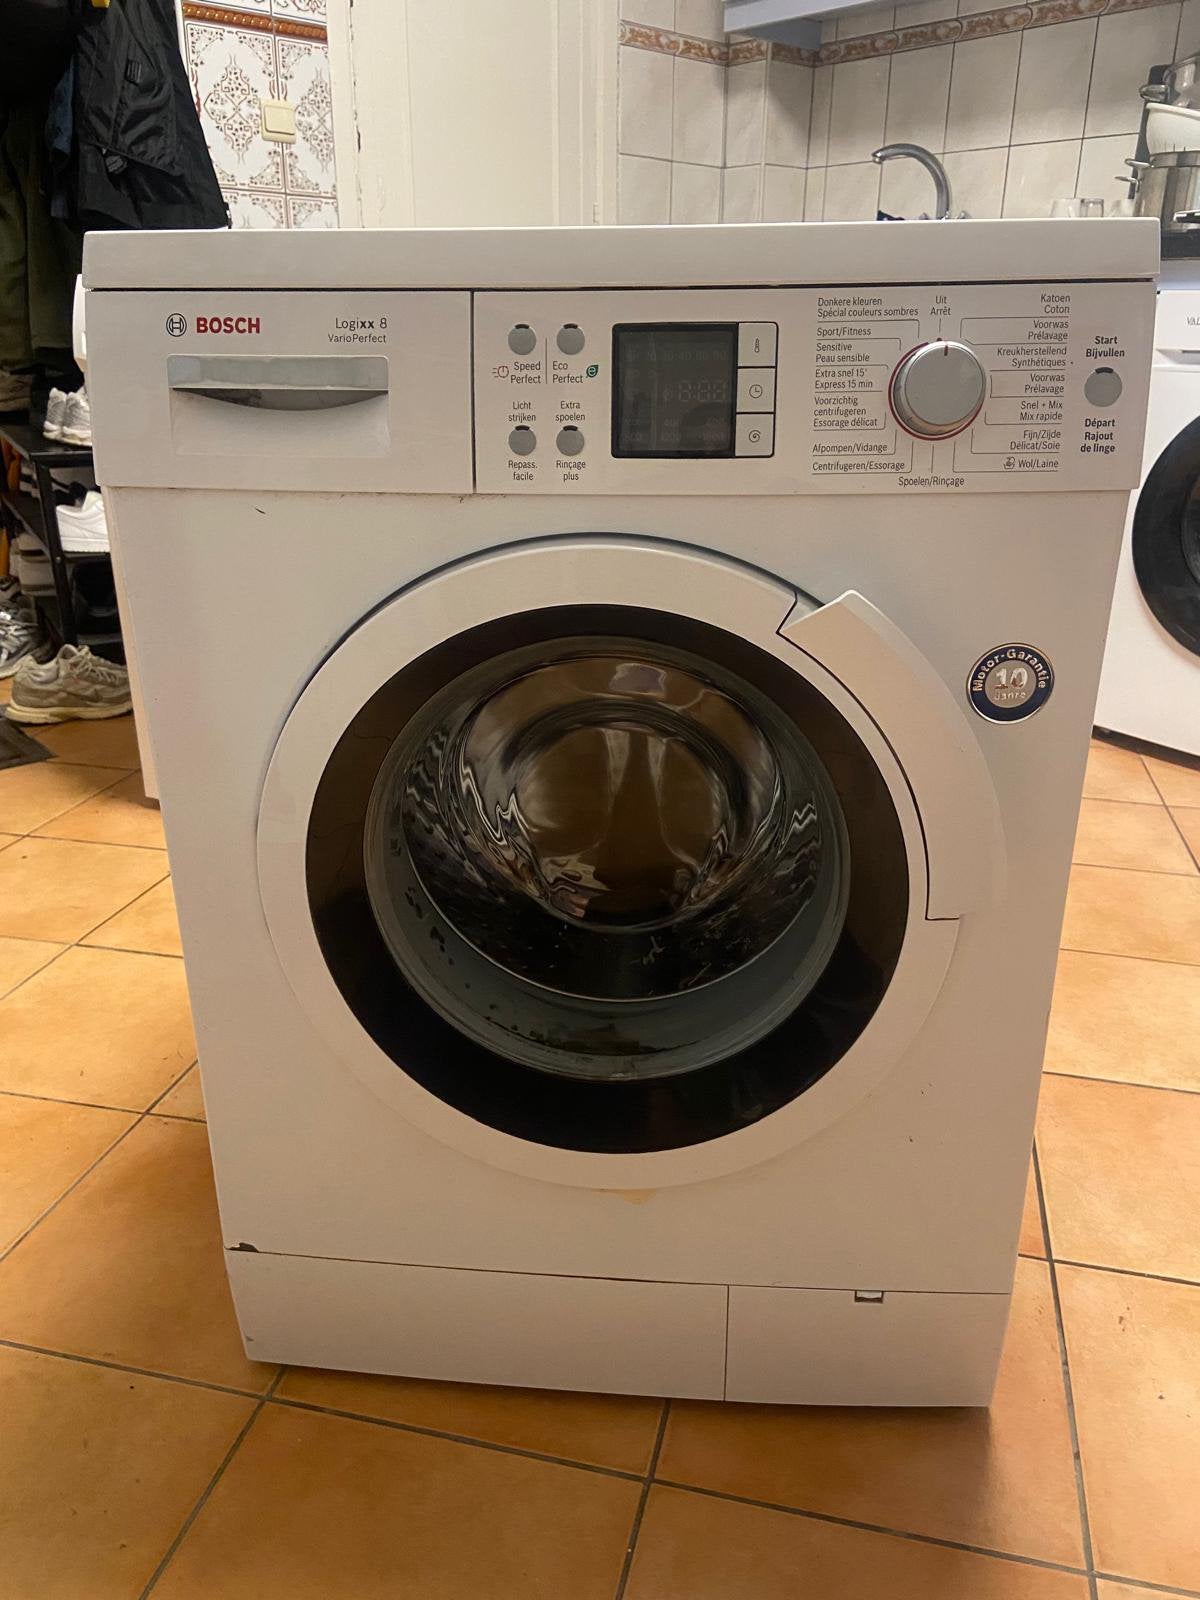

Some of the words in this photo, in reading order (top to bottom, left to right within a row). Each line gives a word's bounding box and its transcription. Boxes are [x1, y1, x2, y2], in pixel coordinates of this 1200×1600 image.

[817, 297, 851, 307] Donkere
[852, 296, 882, 306] kleuren
[935, 296, 947, 305] Uit
[1040, 294, 1071, 303] Katoen
[817, 308, 847, 319] Spécial
[848, 308, 882, 317] couleurs
[883, 307, 919, 316] sombres
[930, 306, 951, 316] Arrêt
[1044, 305, 1070, 314] Coton
[195, 317, 261, 334] BOSCH
[335, 317, 375, 331] Logixx
[379, 317, 388, 330] 8
[1033, 320, 1069, 329] Voorwas
[816, 327, 871, 337] Sport/Fitness
[1028, 331, 1069, 341] Prélavage
[327, 333, 387, 344] VarioPerfect
[1095, 336, 1118, 345] Start
[816, 342, 853, 351] Sensitive
[997, 347, 1067, 356] Kreukherstellend
[815, 354, 835, 362] Peau
[837, 353, 870, 362] sensible
[1086, 348, 1125, 359] Bijvullen
[514, 361, 541, 373] Speed
[552, 361, 568, 371] Eco
[1011, 358, 1066, 369] Synthétiques
[815, 369, 836, 378] Extra
[1030, 373, 1066, 383] Voorwas
[510, 375, 541, 384] Perfect
[552, 374, 583, 384] Perfect
[815, 380, 846, 390] Express
[847, 380, 857, 388] 15
[858, 380, 873, 388] min
[1024, 384, 1065, 395] Prélavage
[512, 401, 532, 410] Licht
[560, 401, 580, 410] Extra
[814, 396, 858, 406] Voorzichtig
[1021, 401, 1039, 410] Snel
[1049, 400, 1063, 409] Mix
[814, 407, 867, 417] centrifugeren
[1020, 412, 1036, 421] Mix
[1037, 412, 1063, 422] rapide
[508, 412, 536, 423] strijken
[555, 412, 585, 423] spoelen
[813, 418, 850, 429] Essorage
[851, 418, 878, 427] délicat
[1085, 418, 1116, 429] Départ
[1023, 430, 1061, 440] Fijn/Zijde
[1085, 431, 1114, 442] Rajout
[812, 443, 888, 454] Afpompen/Vidange
[1010, 441, 1061, 450] Délicat/Soie
[1080, 444, 1092, 453] de
[1093, 444, 1116, 454] linge
[508, 460, 538, 470] Repass.
[556, 460, 586, 471] Rinçage
[812, 461, 905, 472] Centrifugeren/Essorage
[1018, 458, 1059, 468] Wol/Laine
[513, 471, 533, 481] facile
[563, 472, 579, 482] plus
[898, 476, 965, 487] Spoelen/Rinçage
[972, 649, 1049, 692] Motor-Garantie
[994, 667, 1028, 690] 10
